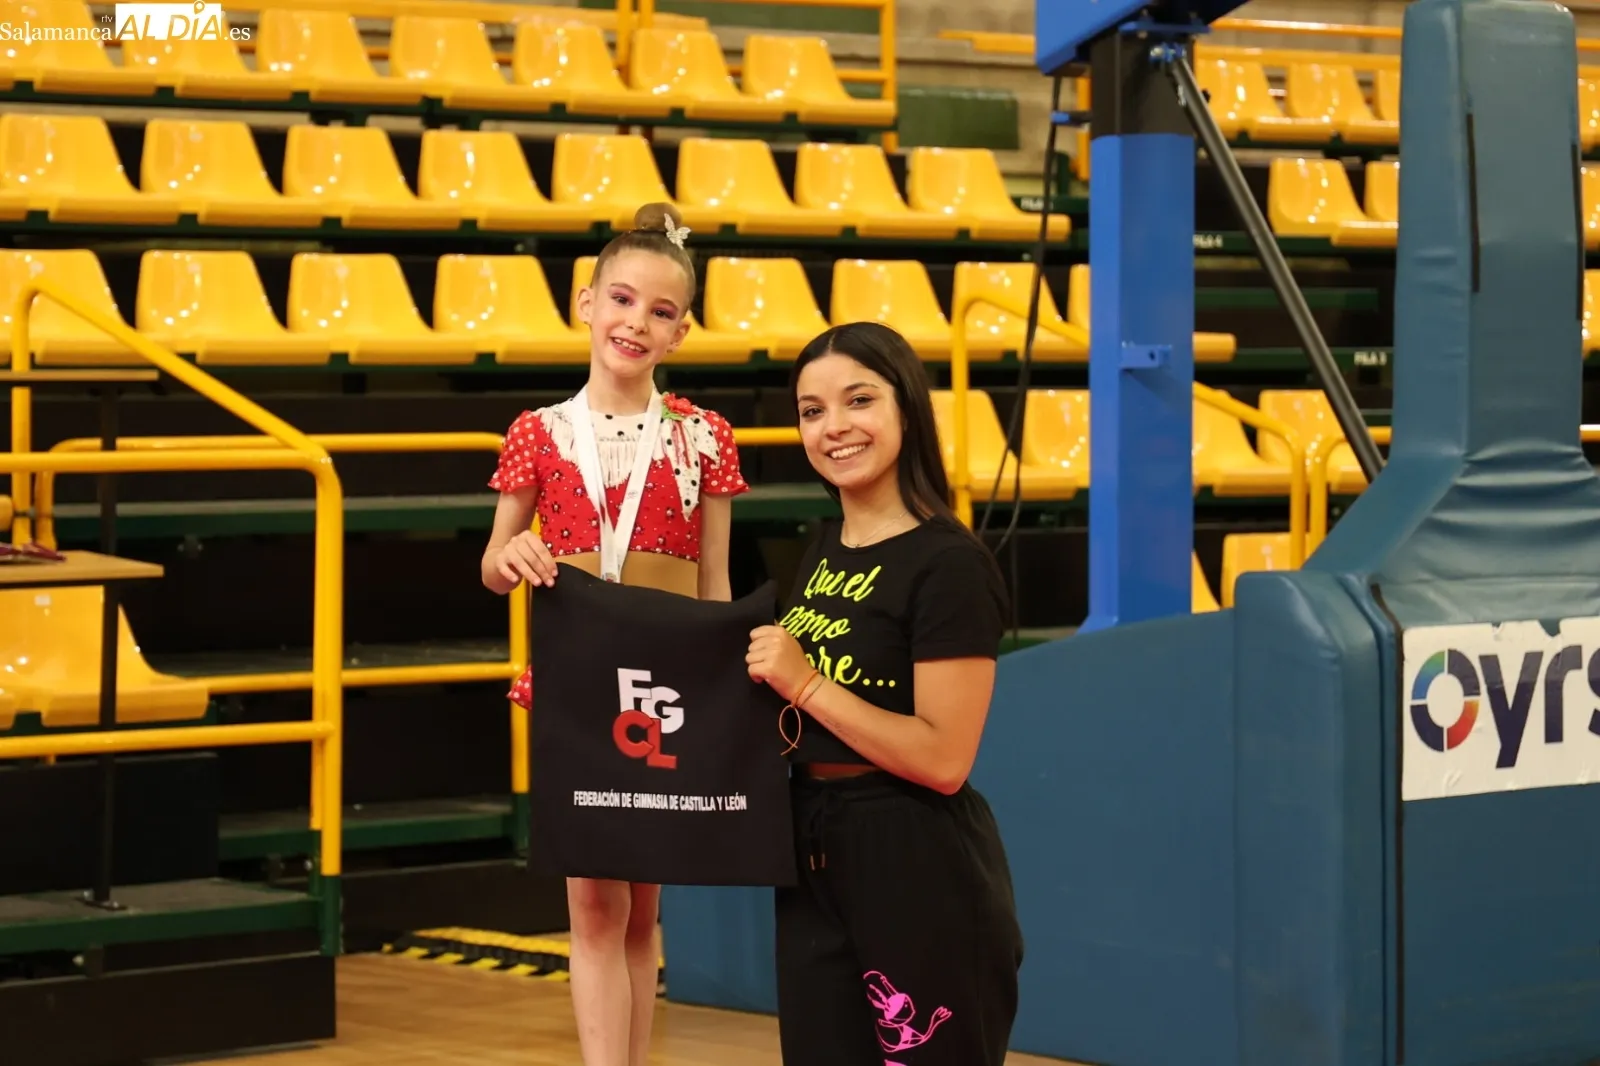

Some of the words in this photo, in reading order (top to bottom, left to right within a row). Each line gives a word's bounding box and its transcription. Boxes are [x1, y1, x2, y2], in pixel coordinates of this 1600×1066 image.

[804, 557, 846, 600] Que
[842, 565, 881, 602] el
[573, 789, 620, 808] FEDERACIÓN
[621, 792, 632, 808] DE
[633, 793, 668, 810] GIMNASIA
[669, 795, 679, 811] DE
[679, 796, 716, 812] CASTILLA
[716, 796, 724, 811] Y
[725, 792, 748, 811] LEÓN
